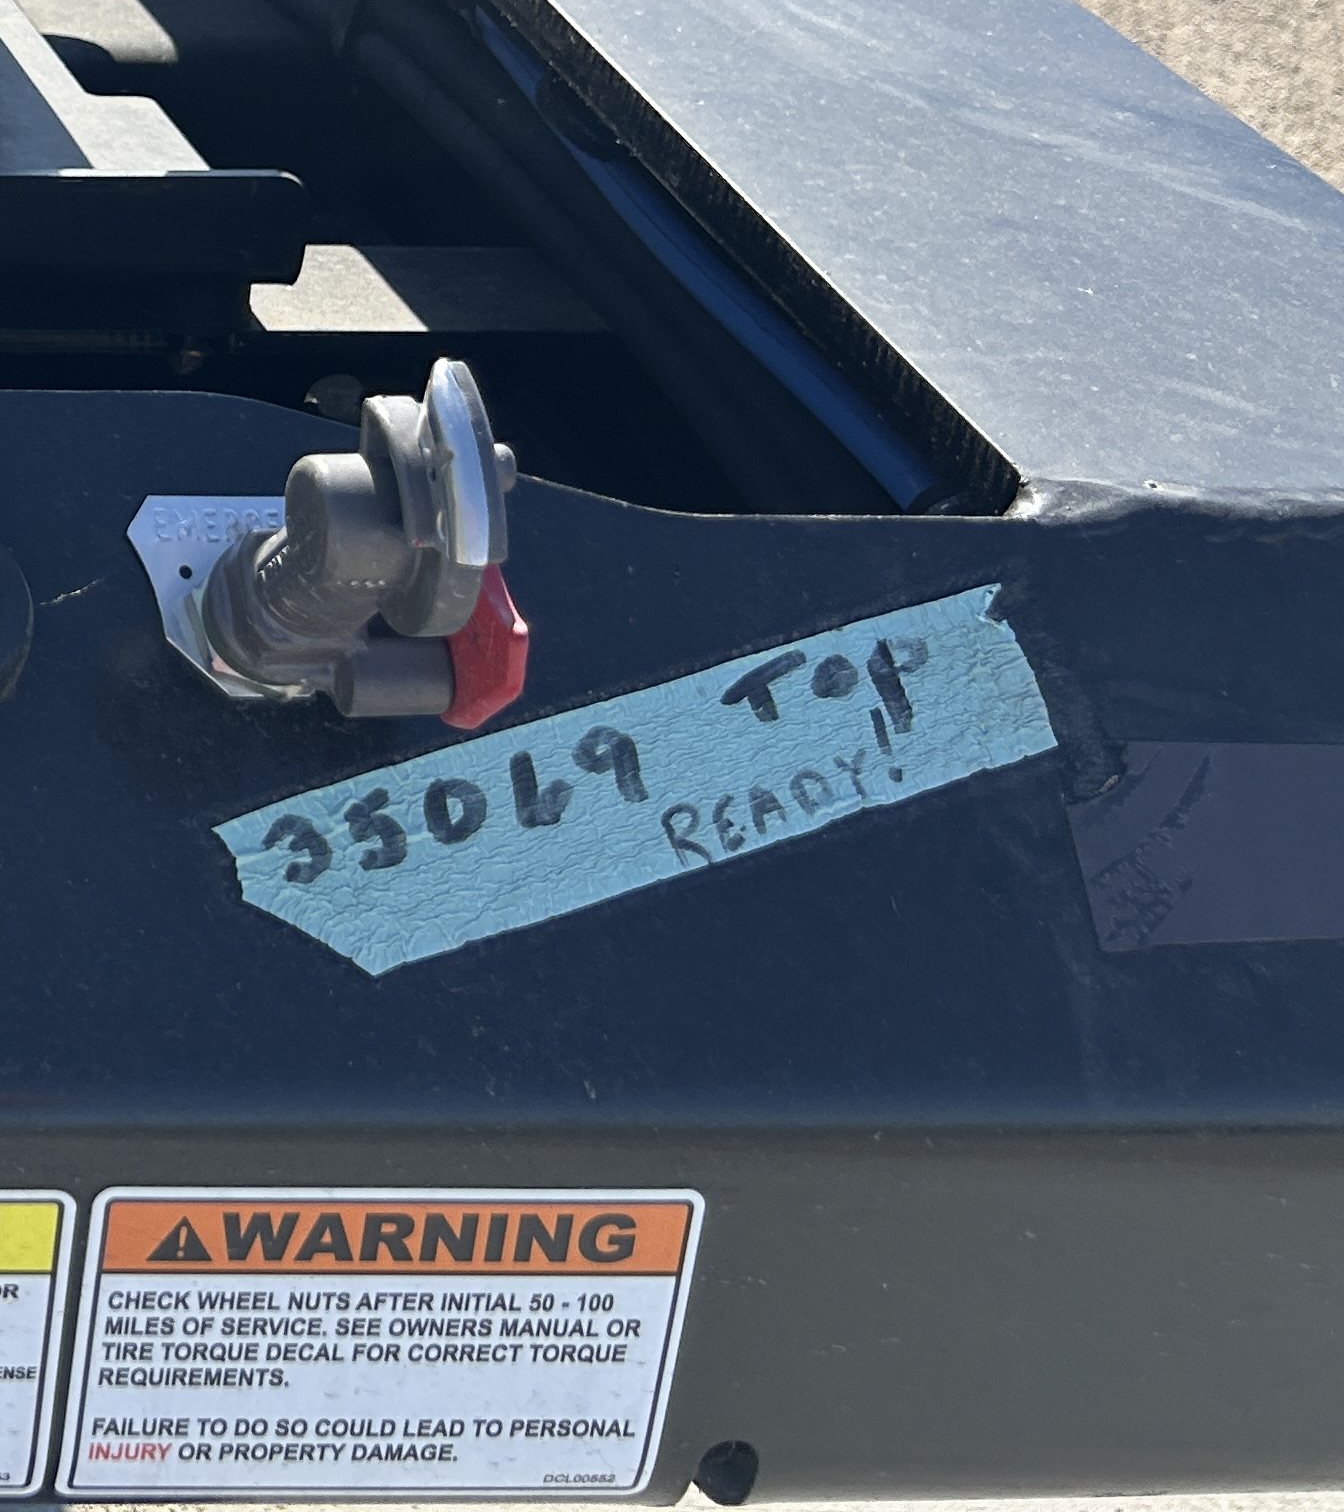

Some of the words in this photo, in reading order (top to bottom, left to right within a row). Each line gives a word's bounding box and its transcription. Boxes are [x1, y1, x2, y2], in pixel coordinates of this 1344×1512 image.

[661, 707, 905, 868] READY!
[262, 725, 649, 885] 35069
[223, 1211, 637, 1264] WARNING
[107, 1291, 191, 1311] CHECK
[197, 1291, 281, 1311] WHEEL
[287, 1291, 351, 1311] NUTS
[355, 1291, 434, 1311] AFTER
[441, 1291, 522, 1311] INITIAL
[528, 1291, 555, 1311] 50
[576, 1291, 614, 1311] 100
[105, 1317, 176, 1337] MILES
[182, 1317, 215, 1337] OF
[221, 1317, 328, 1337] SERVICE.
[334, 1317, 382, 1337] SEE
[389, 1317, 492, 1337] OWNERS
[499, 1317, 599, 1337] MANUAL
[606, 1317, 641, 1337] OR
[101, 1343, 153, 1363] TIRE
[160, 1343, 259, 1363] TORQUE
[265, 1343, 345, 1363] DECAL
[352, 1343, 400, 1363] FOR
[408, 1343, 523, 1363] CORRECT
[530, 1343, 628, 1363] TORQUE
[98, 1368, 290, 1387] REQUIREMENTS.
[92, 1418, 189, 1438] FAILURE
[196, 1418, 227, 1438] TO
[234, 1418, 268, 1438] DO
[275, 1418, 309, 1438] SO
[314, 1418, 395, 1438] COULD
[401, 1418, 466, 1438] LEAD
[473, 1418, 503, 1438] TO
[510, 1418, 636, 1438] PERSONAL
[88, 1442, 172, 1462] INJURY
[177, 1442, 213, 1462] OR
[218, 1442, 346, 1462] PROPERTY
[351, 1442, 459, 1462] DAMAGE.
